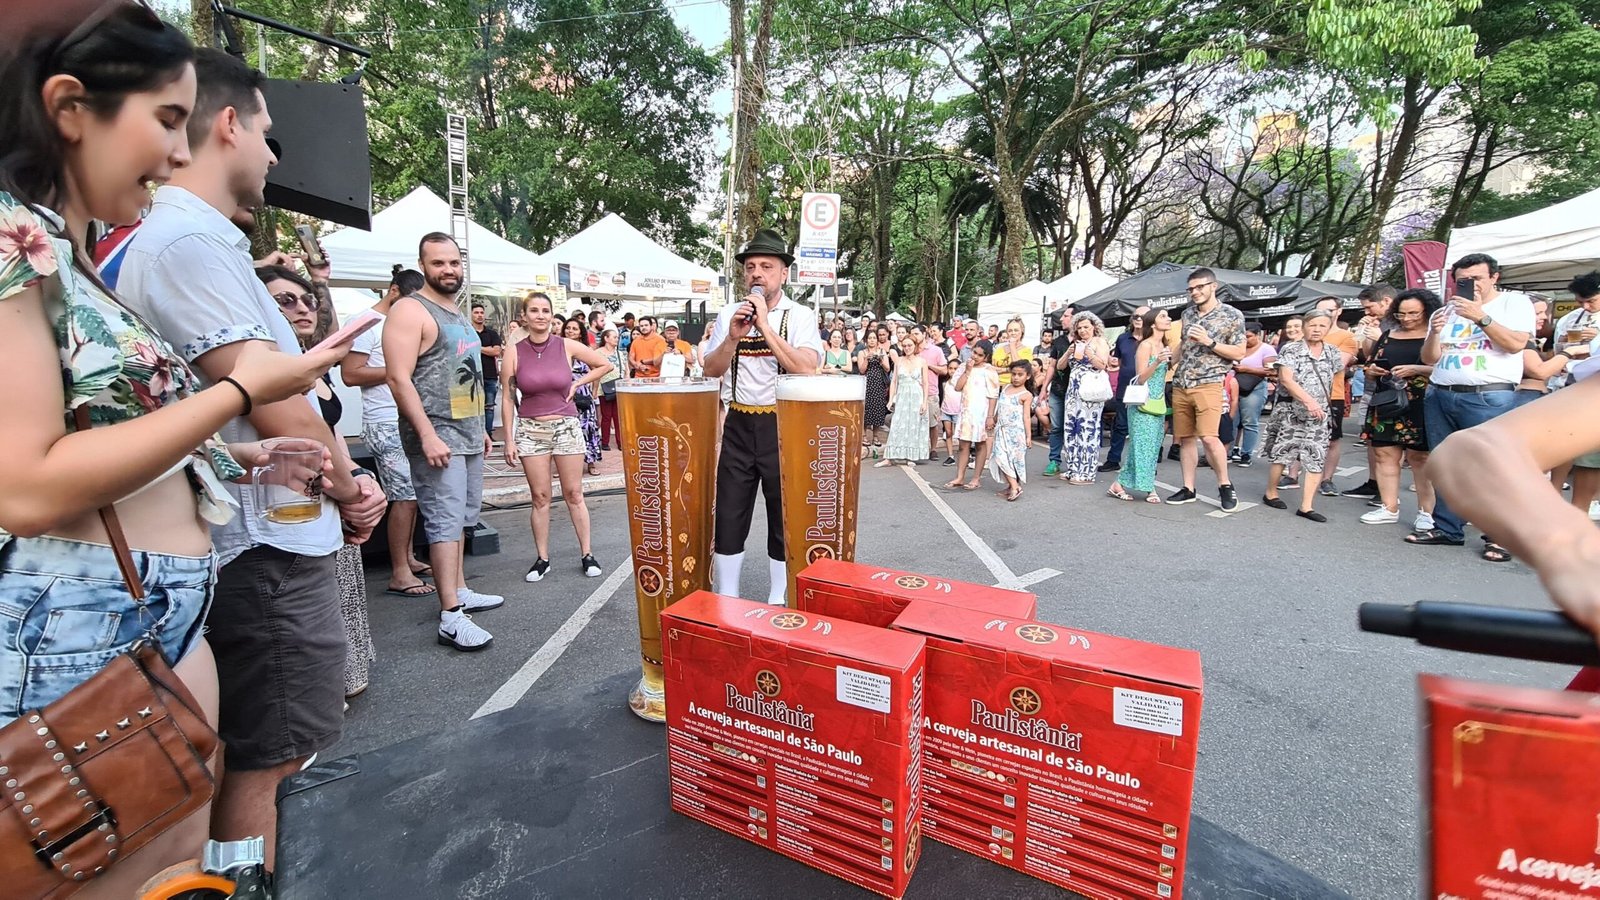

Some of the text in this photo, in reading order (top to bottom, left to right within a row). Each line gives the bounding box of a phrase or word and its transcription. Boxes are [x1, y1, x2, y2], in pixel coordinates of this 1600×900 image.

[815, 203, 827, 222] E
[1147, 295, 1188, 308] Paulistânia
[1249, 285, 1277, 296] Paulistânia
[632, 435, 663, 565] Paulistânia
[806, 425, 839, 542] Paulistânia
[726, 683, 814, 731] Paulistânia
[971, 699, 1081, 751] Paulistânia
[689, 702, 862, 766] A cerveja artesanal de São Paulo
[923, 717, 1140, 789] A cerveja artesanal de São Paulo
[1497, 848, 1519, 872] A
